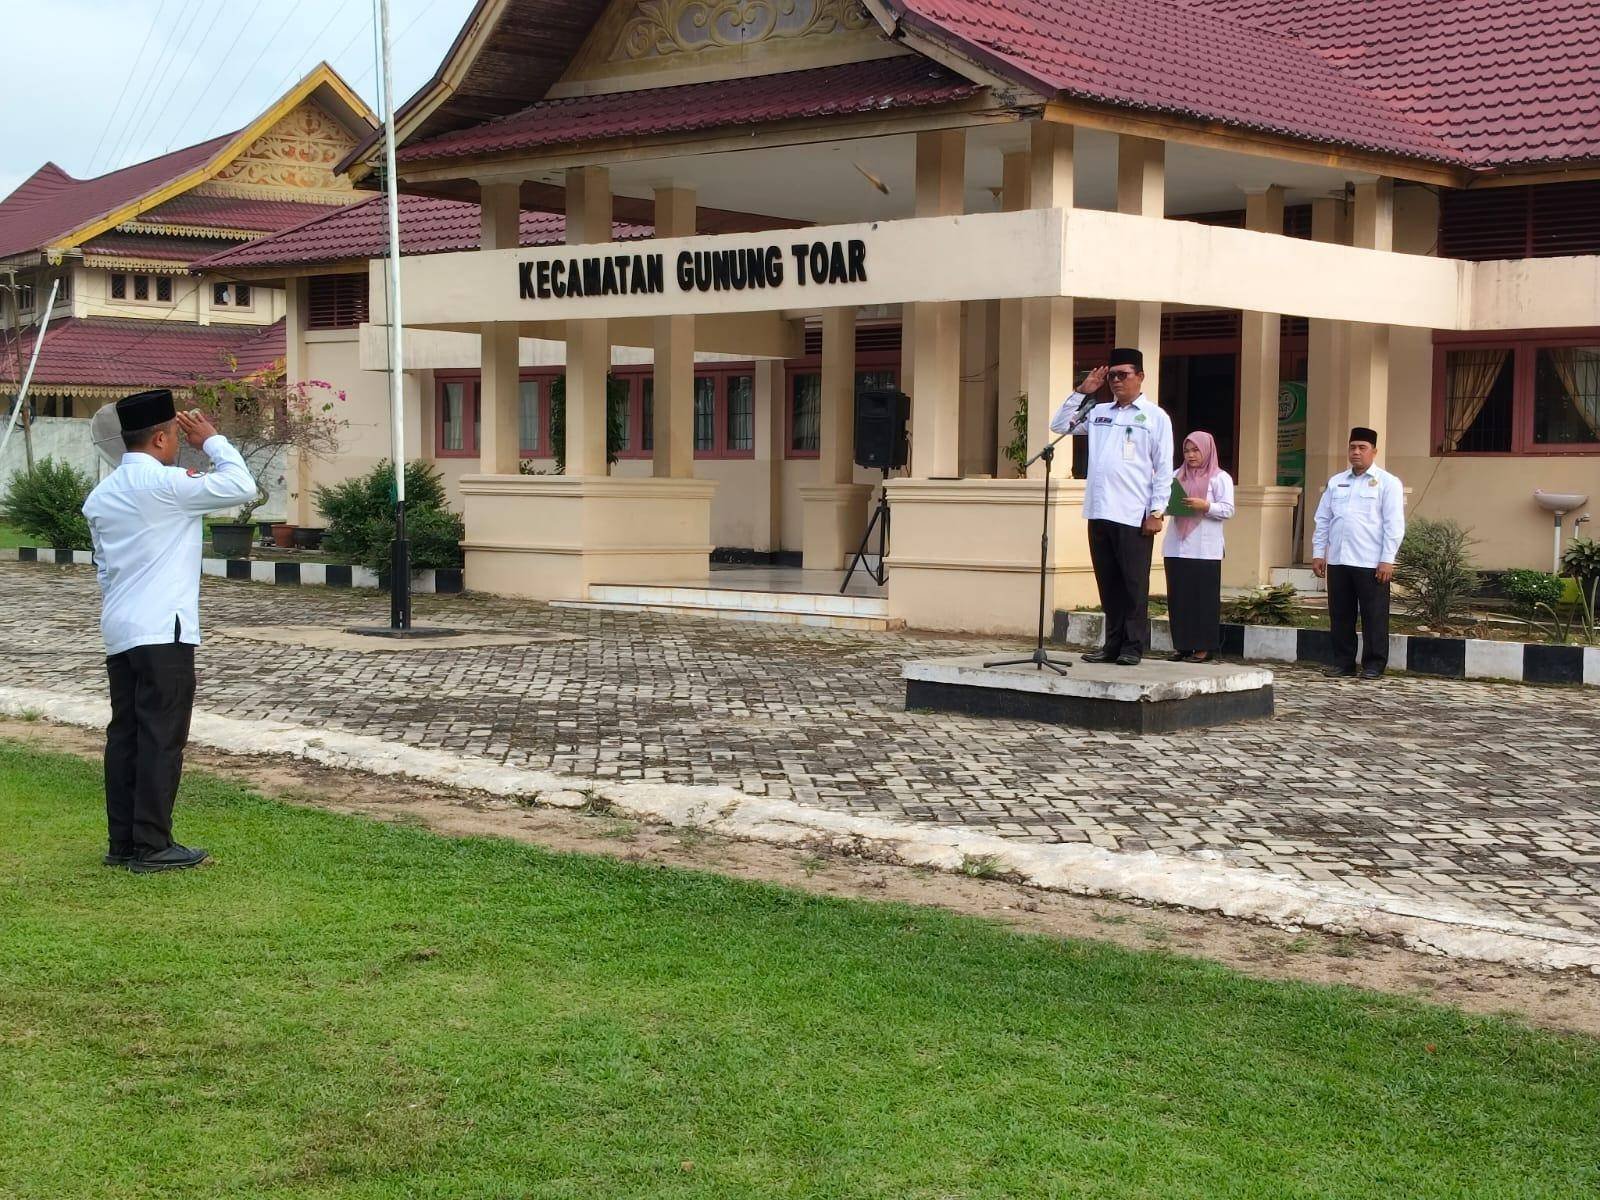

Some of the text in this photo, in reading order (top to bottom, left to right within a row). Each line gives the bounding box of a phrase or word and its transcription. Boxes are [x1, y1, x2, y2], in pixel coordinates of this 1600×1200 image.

[519, 240, 867, 299] KECAMATAN GUNUNG TOAR
